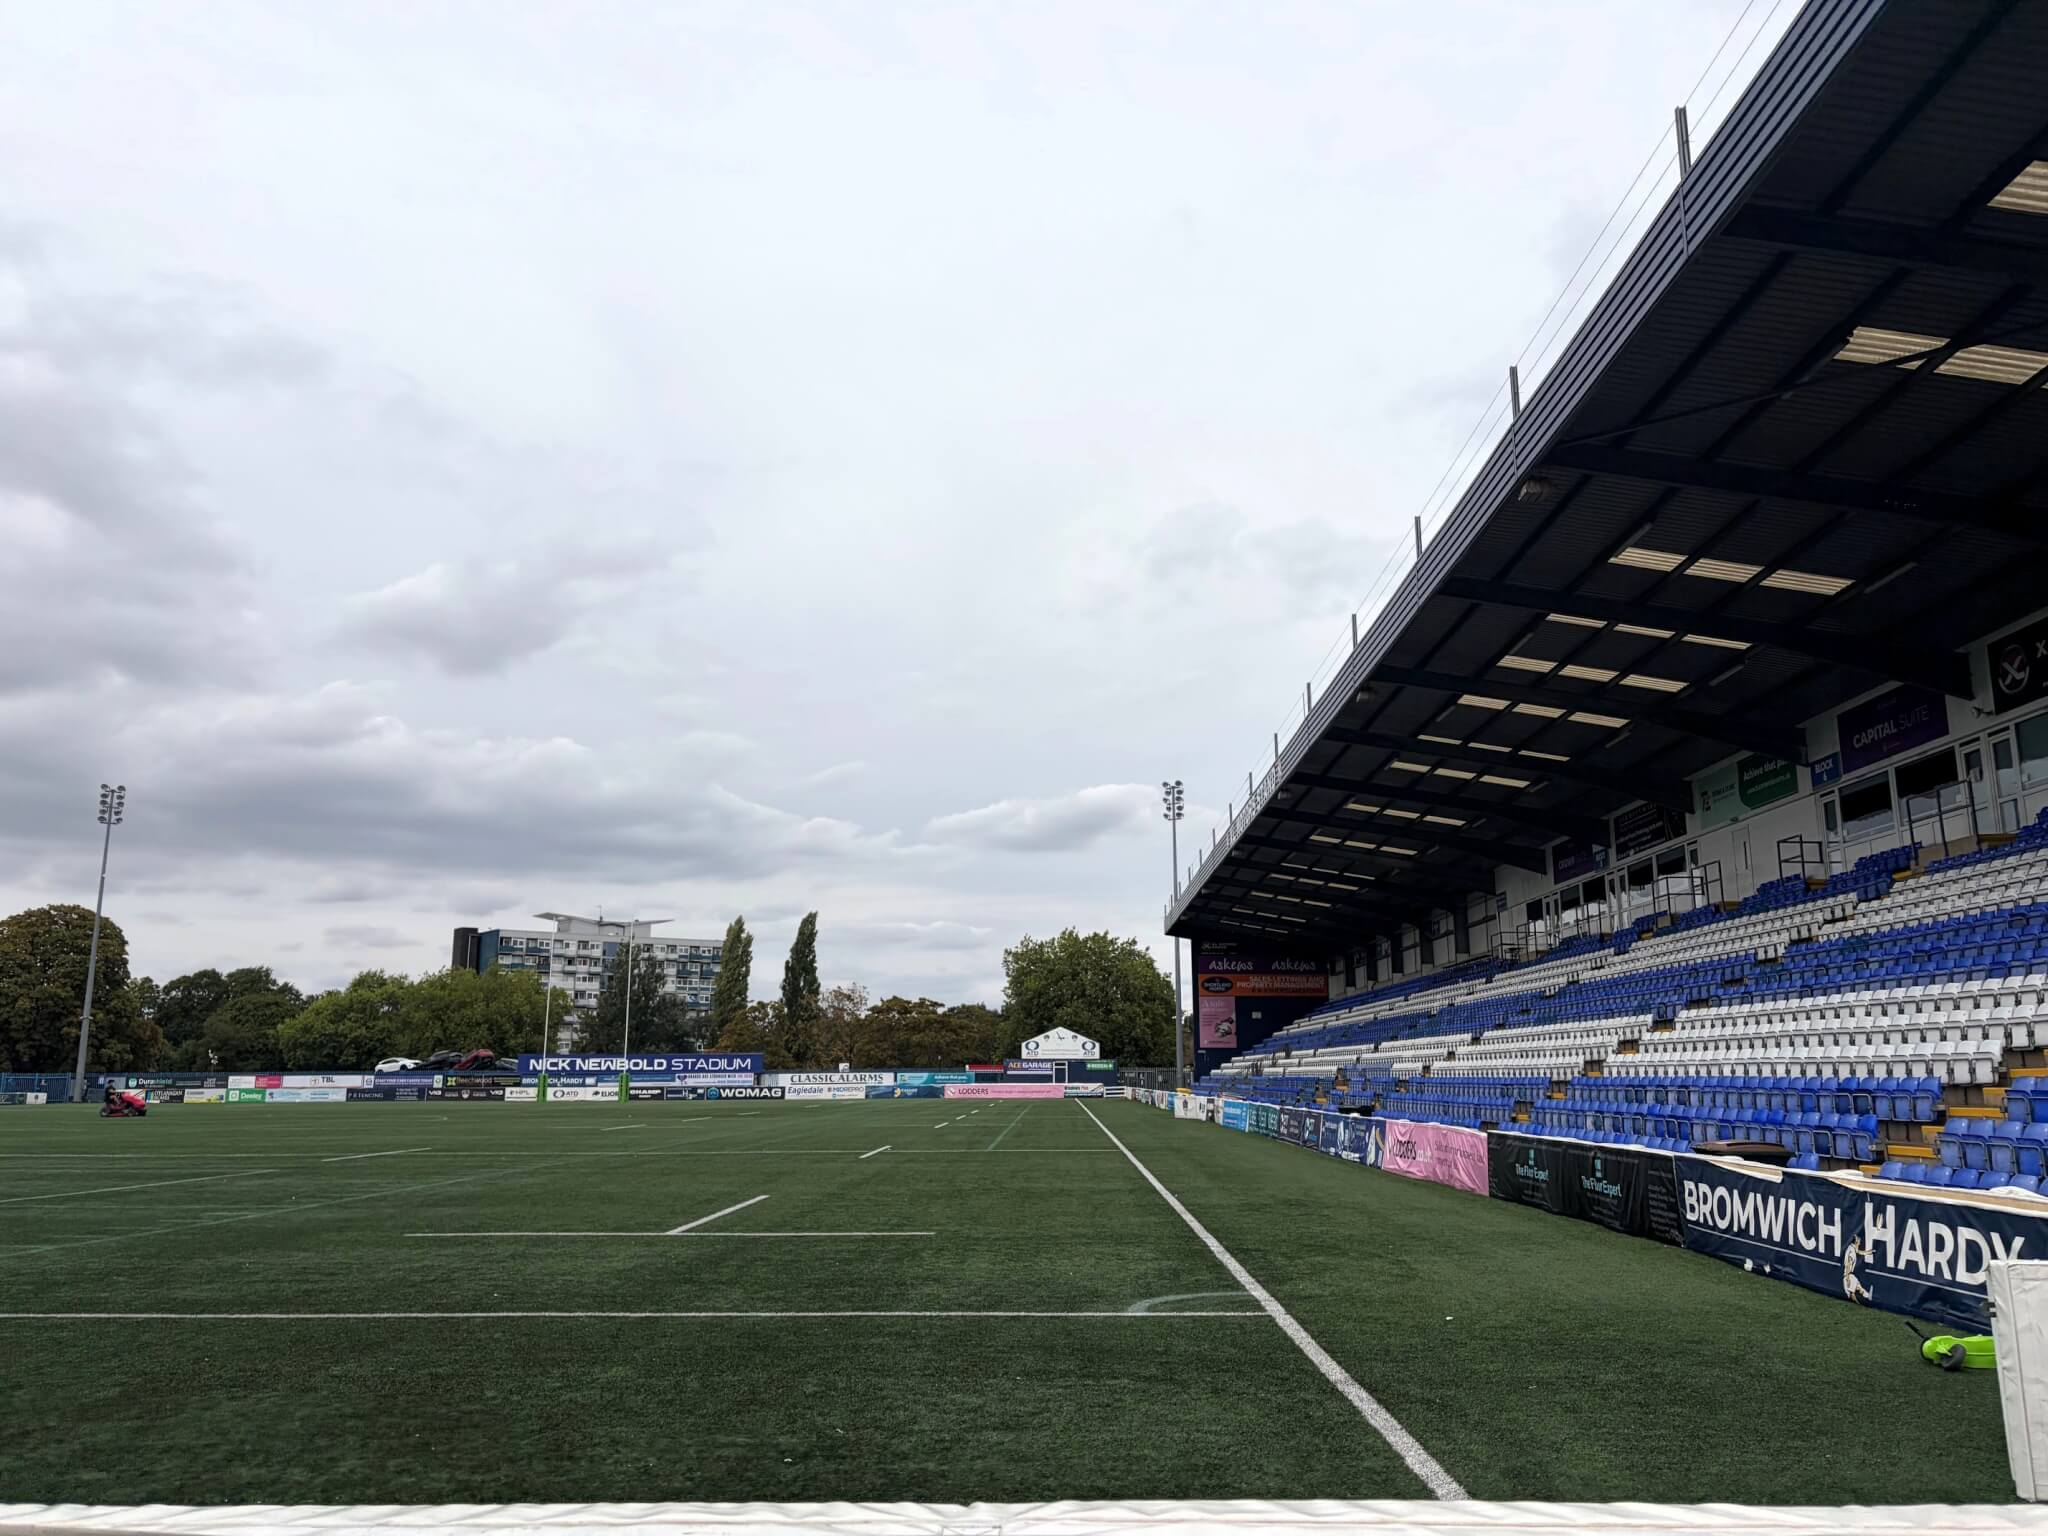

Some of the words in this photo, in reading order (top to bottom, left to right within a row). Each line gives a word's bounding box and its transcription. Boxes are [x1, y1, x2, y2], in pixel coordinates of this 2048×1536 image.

[1853, 719, 1898, 749] CAPITAL
[1898, 704, 1930, 730] SUITE
[1814, 758, 1835, 774] BLOCK
[529, 1058, 571, 1071] NICK
[576, 1058, 667, 1071] NEWBOLD
[672, 1058, 751, 1071] STADIUM
[790, 1074, 838, 1083] CLASSIC
[838, 1073, 884, 1083] ALARMS
[720, 1088, 782, 1097] WOMAG
[1683, 1180, 1842, 1257] BROMWICH
[1864, 1201, 2025, 1286] HARDY
